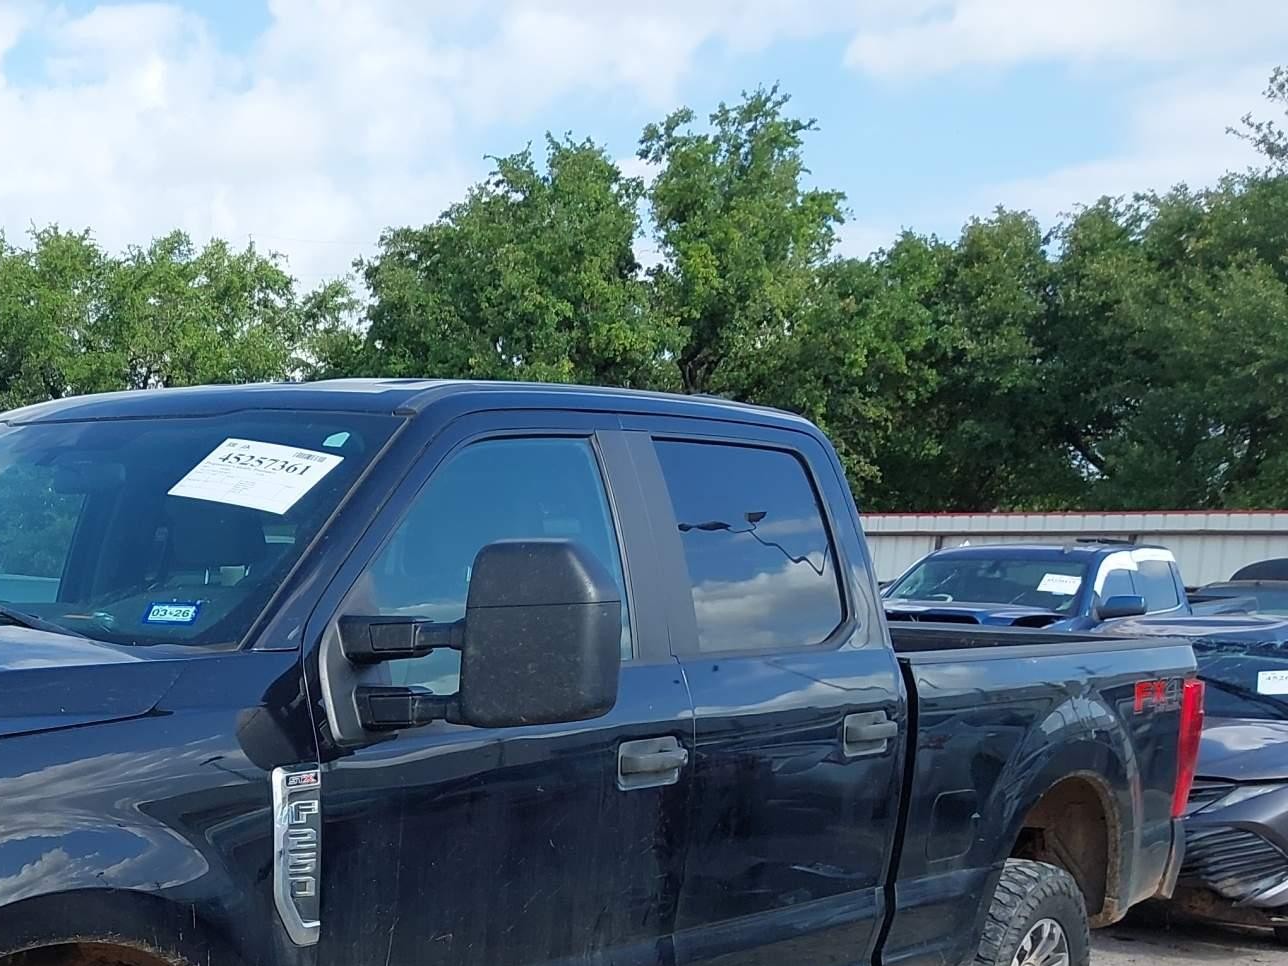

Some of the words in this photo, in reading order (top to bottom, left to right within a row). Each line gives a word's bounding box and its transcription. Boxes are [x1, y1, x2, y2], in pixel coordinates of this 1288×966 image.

[218, 451, 312, 476] 45257361
[1134, 676, 1184, 715] FX4
[287, 775, 316, 786] STX
[287, 800, 319, 897] F250
